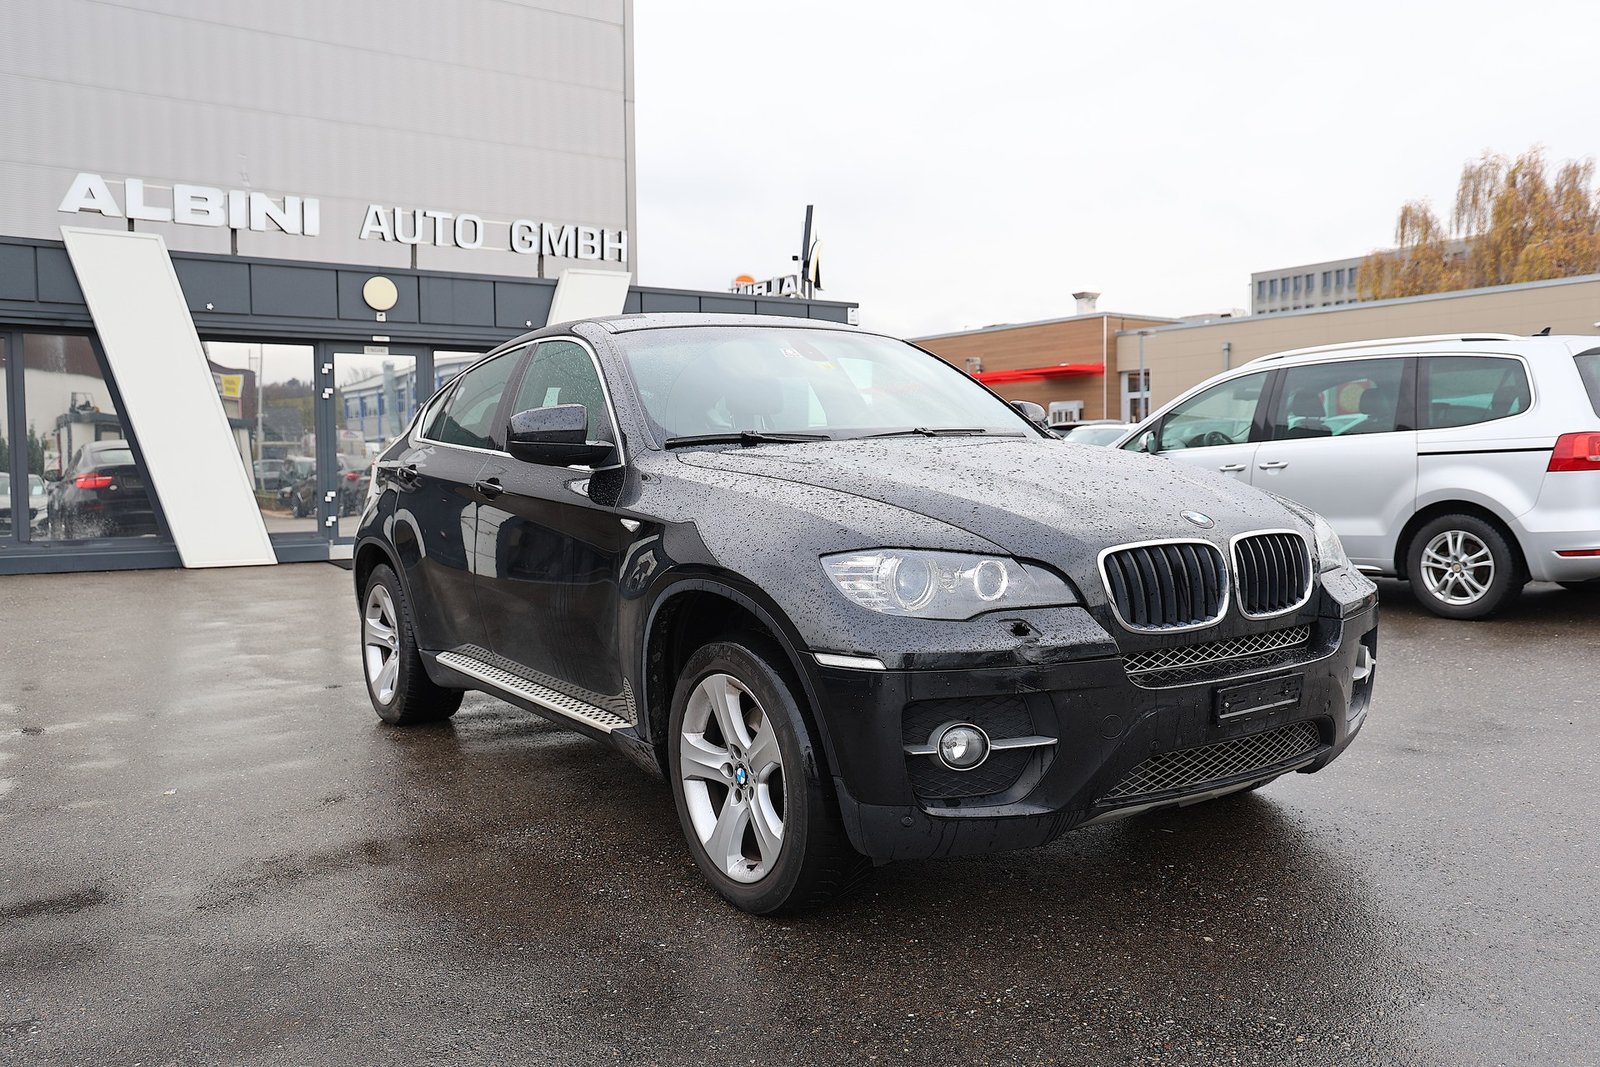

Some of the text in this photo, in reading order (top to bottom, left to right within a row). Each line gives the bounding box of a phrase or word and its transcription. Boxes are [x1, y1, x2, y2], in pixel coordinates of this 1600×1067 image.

[57, 172, 628, 262] ALBINI AUTO GMBH
